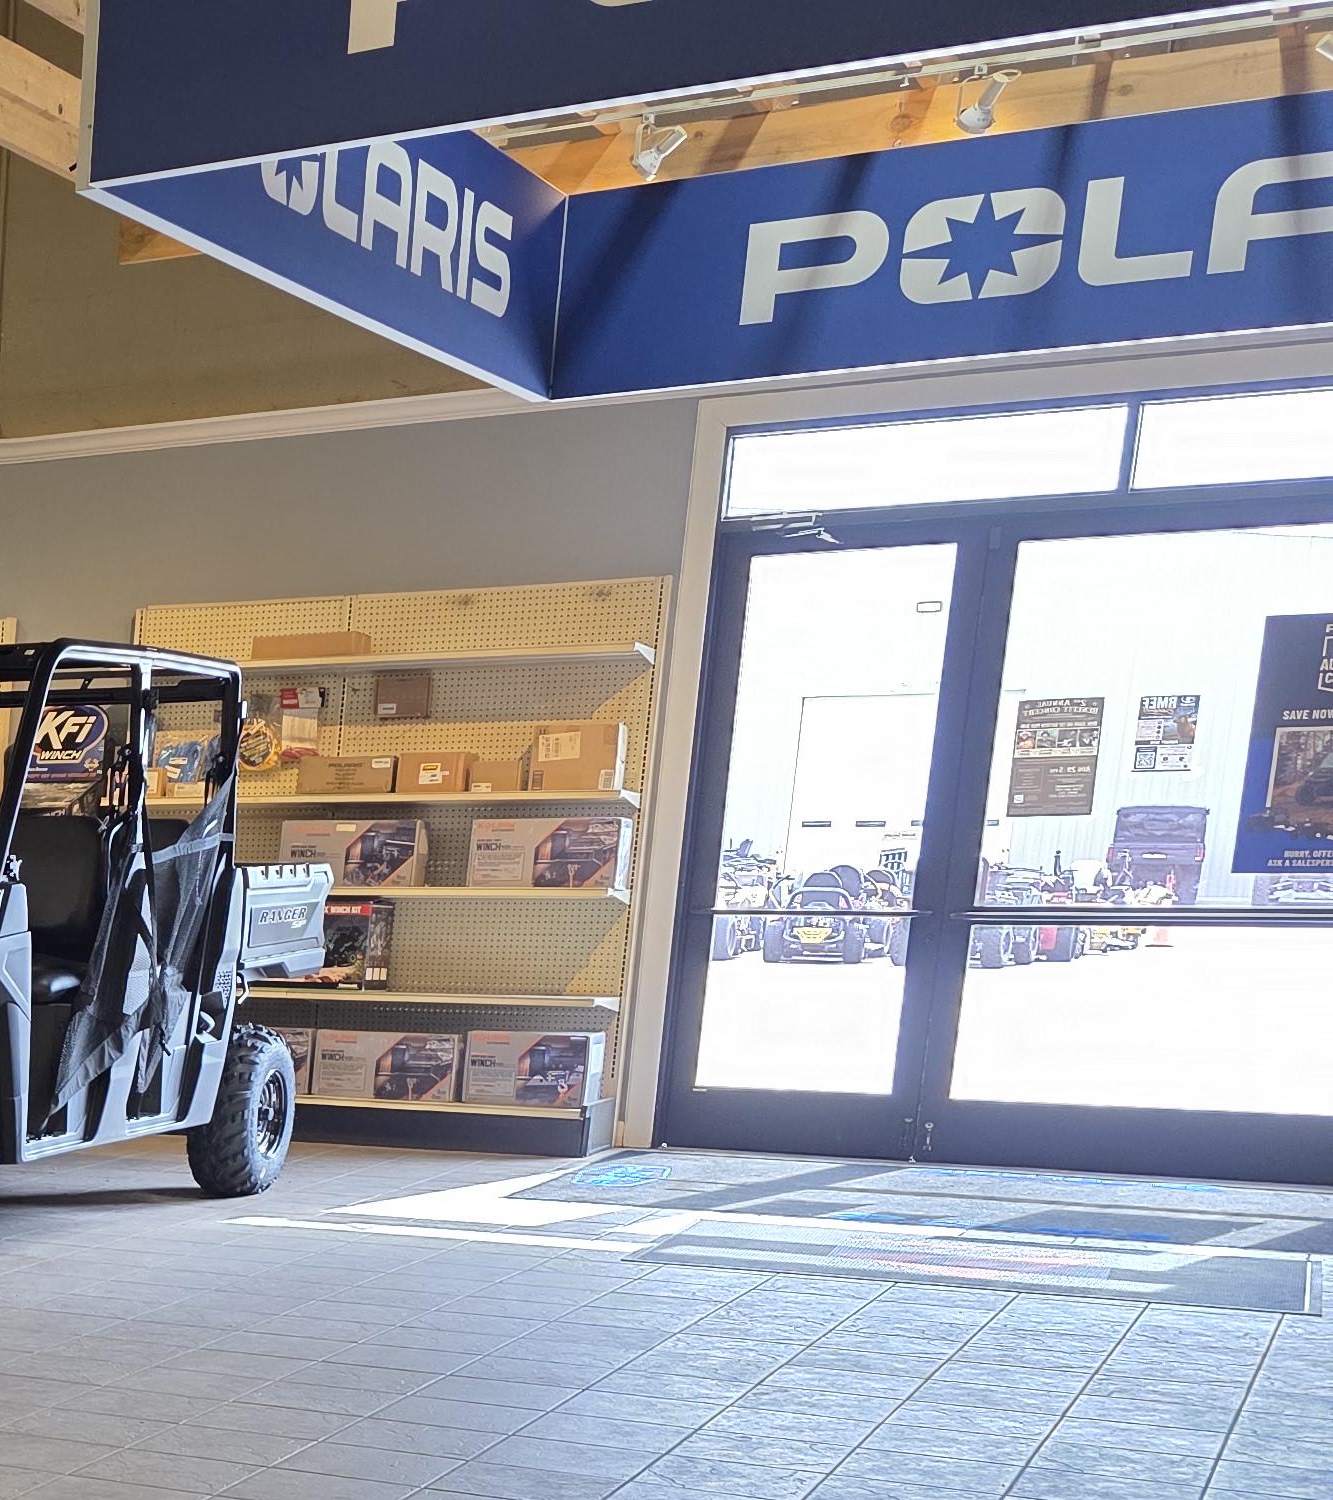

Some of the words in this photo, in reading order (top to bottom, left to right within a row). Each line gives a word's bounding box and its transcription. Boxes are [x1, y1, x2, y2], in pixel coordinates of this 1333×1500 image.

[260, 141, 514, 318] OLARIS
[1282, 709, 1310, 720] SAVE
[1312, 708, 1333, 720] NOW
[40, 749, 83, 761] WINCH
[476, 842, 501, 851] WINCH
[290, 849, 316, 859] WINCH
[1267, 859, 1283, 867] ASK
[1284, 859, 1291, 867] A
[258, 906, 308, 925] RANGER
[321, 1052, 345, 1062] WINCH
[470, 1058, 496, 1067] WINCH
